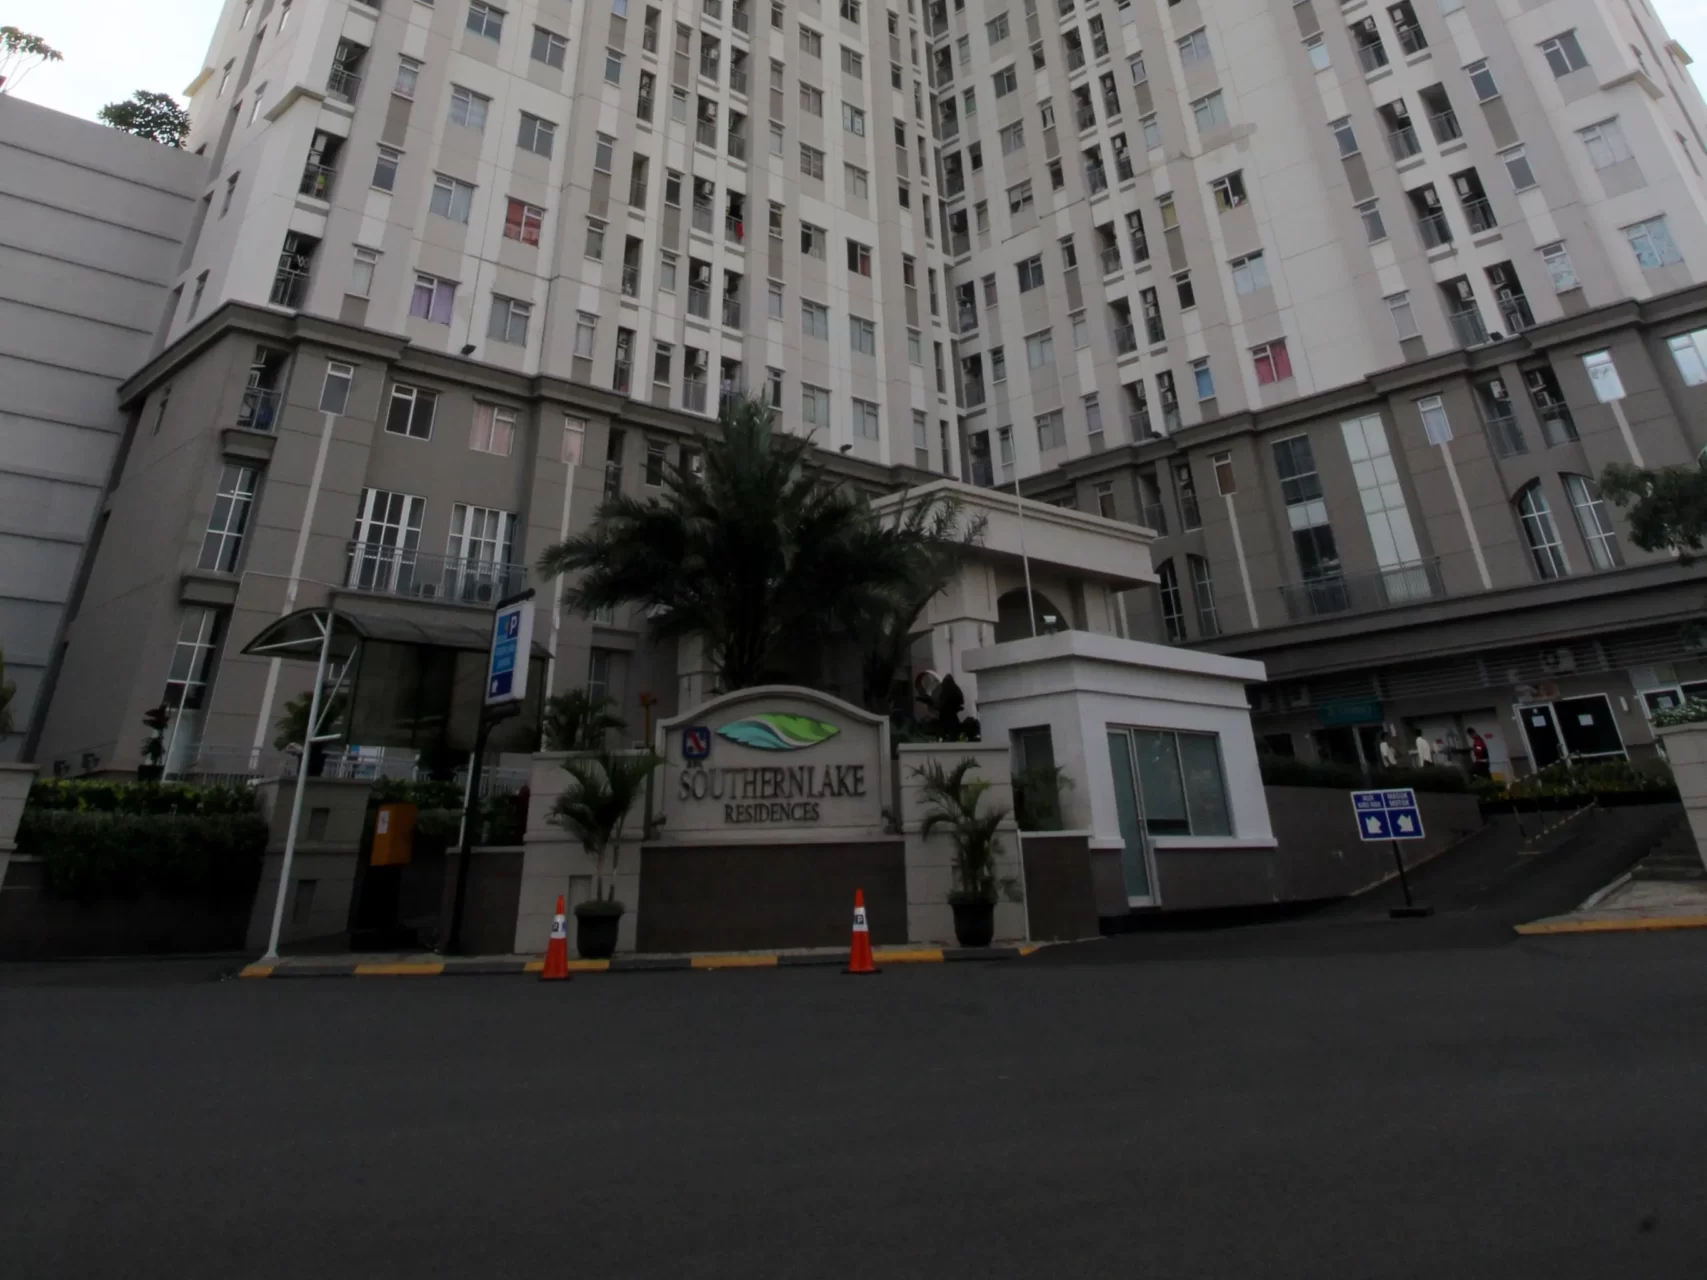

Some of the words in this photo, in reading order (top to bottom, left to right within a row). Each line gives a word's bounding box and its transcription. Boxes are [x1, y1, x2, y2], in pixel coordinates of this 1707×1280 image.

[510, 615, 517, 634] P
[678, 764, 867, 802] SOUTHERNLAKE
[725, 803, 820, 824] RESIDENCES
